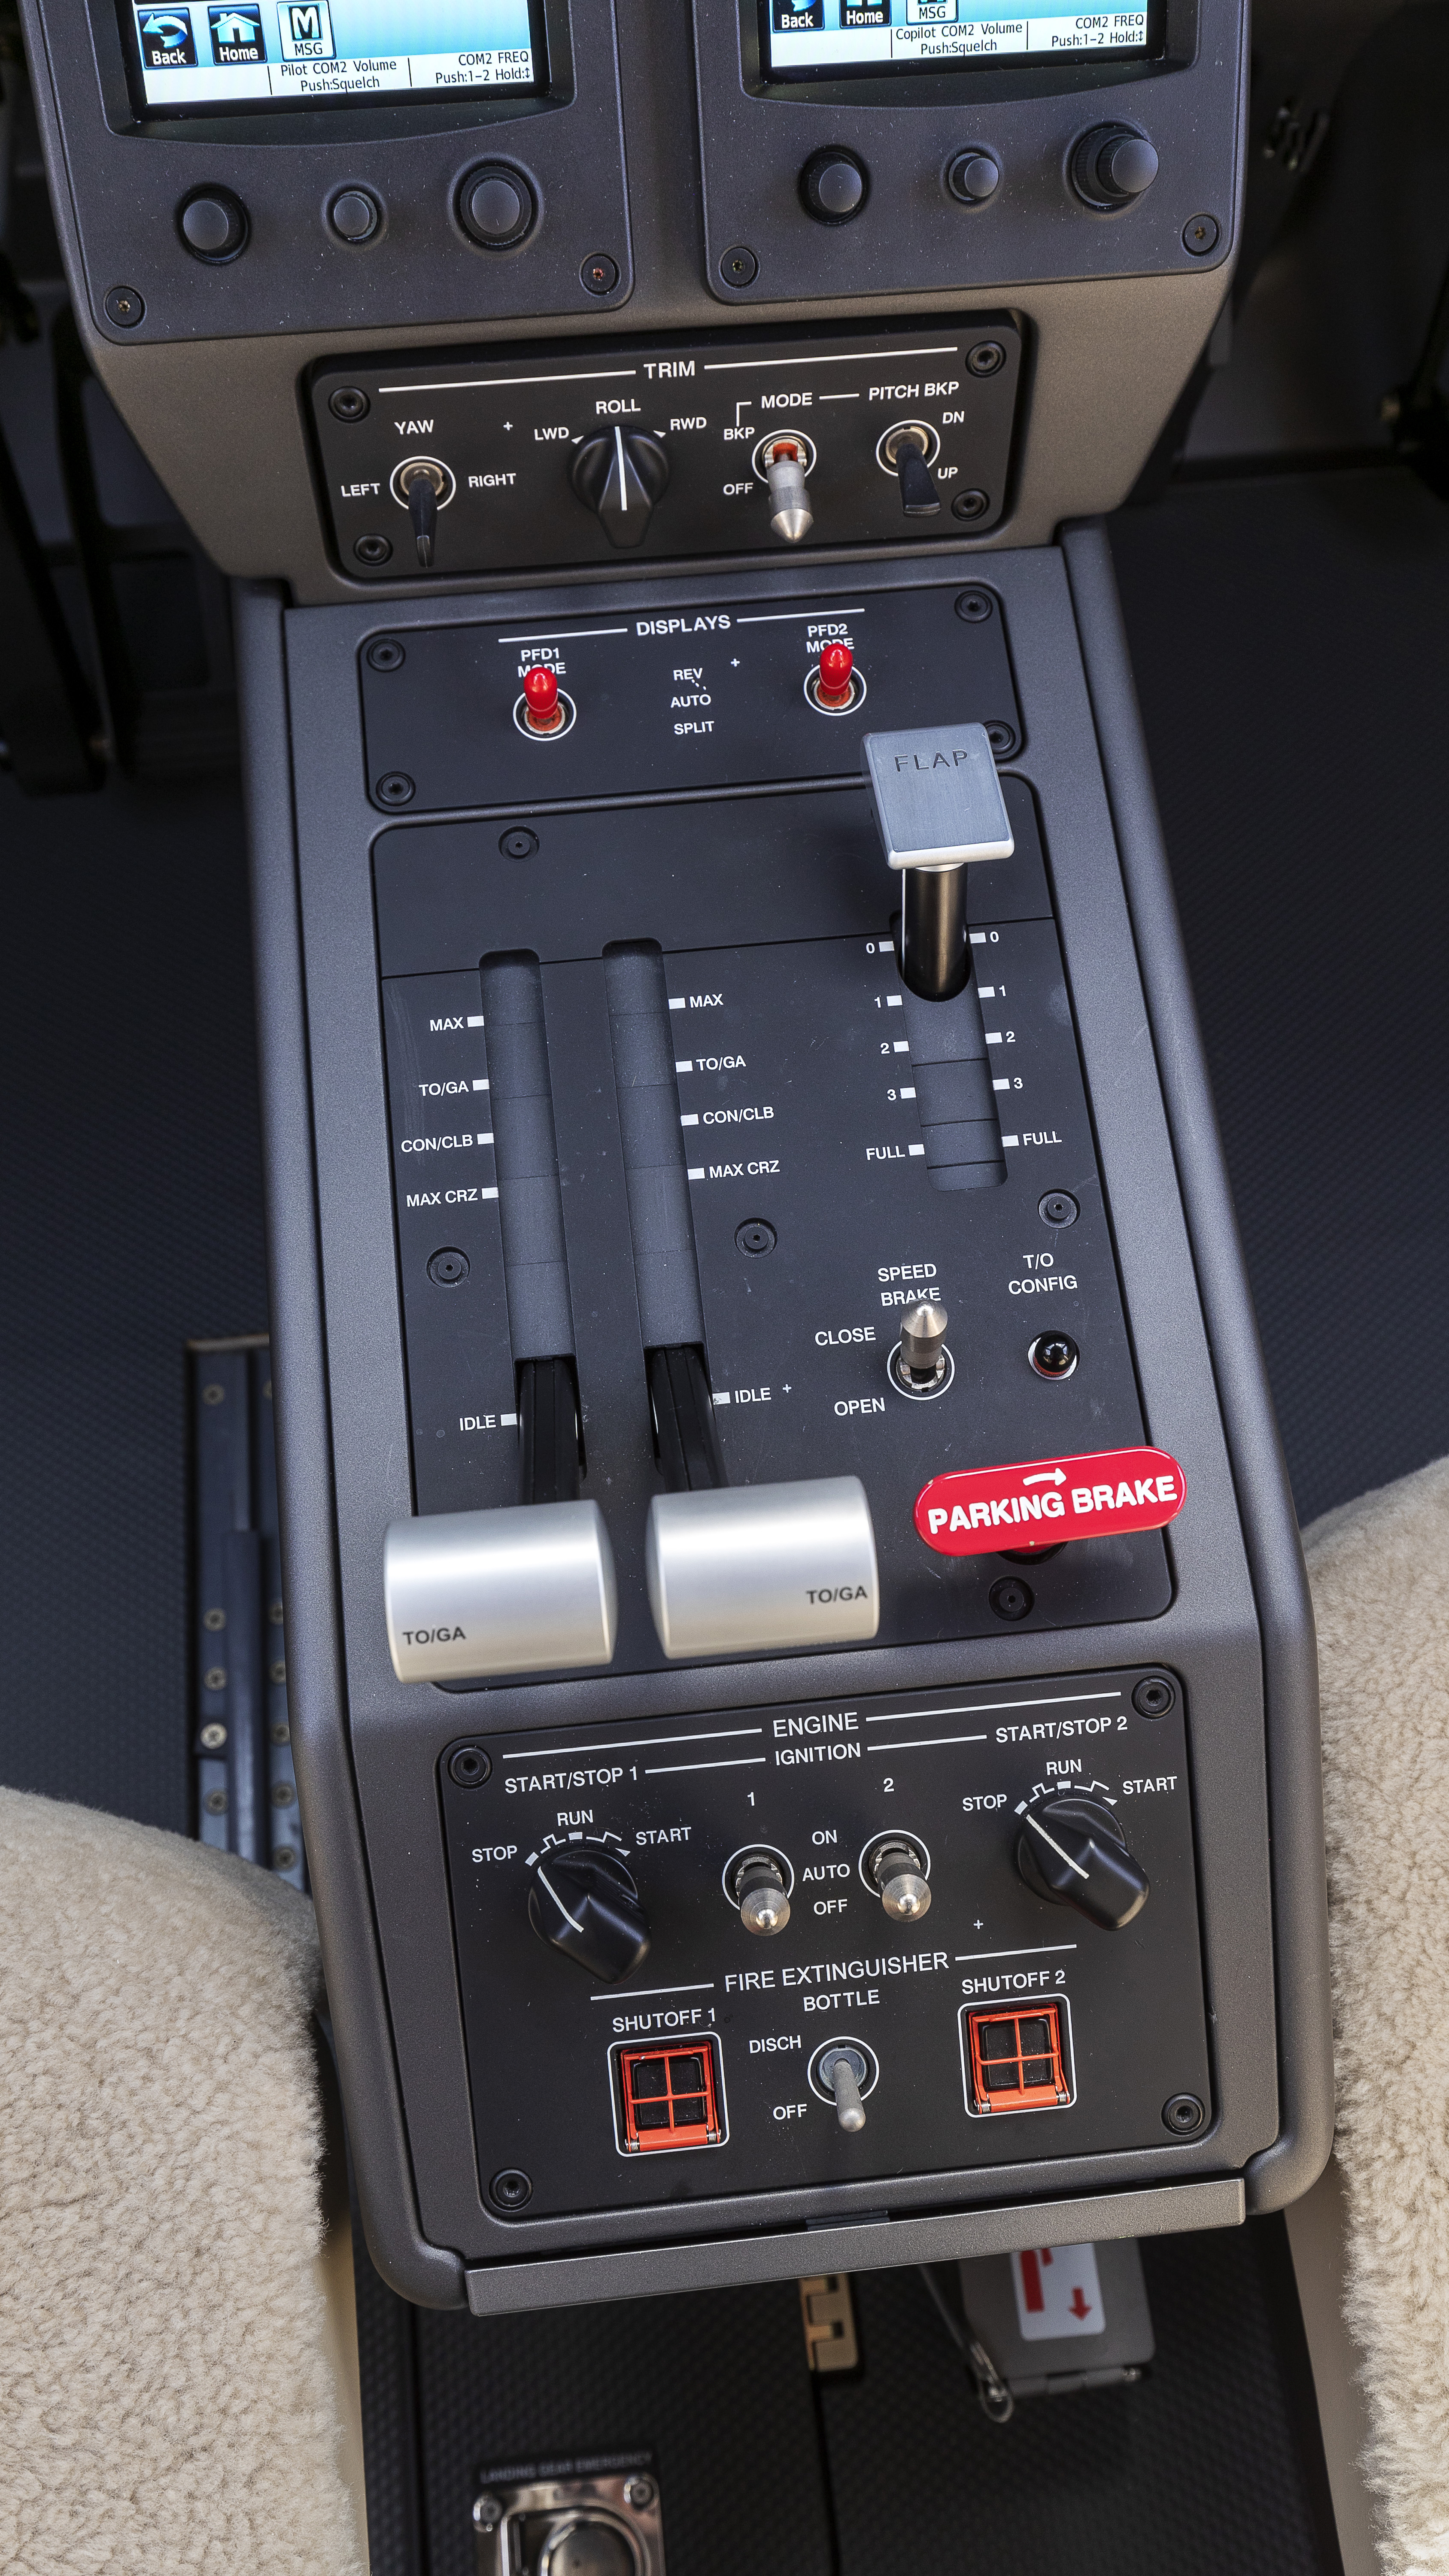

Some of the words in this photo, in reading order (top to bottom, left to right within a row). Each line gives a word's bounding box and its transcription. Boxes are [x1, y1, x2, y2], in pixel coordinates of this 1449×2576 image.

[781, 14, 814, 28] Back
[847, 11, 884, 24] Home
[919, 7, 945, 19] MSG
[1075, 17, 1108, 28] COM2
[1114, 15, 1144, 27] FREQ
[896, 27, 936, 42] Copilot
[942, 25, 974, 36] COM2
[981, 22, 1022, 34] Volume
[220, 47, 258, 61] Home
[295, 44, 323, 56] MSG
[921, 39, 997, 56] Push:Squelch
[152, 50, 186, 65] Back
[459, 54, 492, 66] COM2
[498, 52, 529, 65] FREQ
[281, 63, 308, 76] Pilot
[313, 62, 347, 74] COM2
[355, 60, 397, 72] Volume
[301, 76, 380, 94] Push:Squelch
[643, 360, 695, 379] TRIM
[869, 384, 919, 401] PITCH
[924, 381, 959, 397] BKP
[596, 398, 641, 414] ROLL
[761, 392, 813, 409] MODE
[670, 417, 707, 431] RWD
[942, 410, 965, 424] DN
[394, 419, 434, 435] YAW
[534, 427, 569, 440] LWD
[724, 427, 755, 440] BKP
[468, 473, 516, 488] RIGHT
[938, 467, 958, 479] UP
[341, 483, 380, 497] LEFT
[723, 483, 753, 495] OFF
[636, 615, 731, 636] DISPLAYS
[808, 624, 848, 637] PFD2
[521, 648, 559, 661] PFD1
[673, 667, 704, 681] REV
[671, 694, 711, 708] AUTO
[674, 720, 714, 735] SPLIT
[894, 749, 968, 772] FLAP
[990, 931, 999, 942] 0
[866, 942, 875, 954] 0
[999, 985, 1006, 996] 1
[690, 993, 724, 1008] MAX
[874, 996, 881, 1008] 1
[430, 1017, 464, 1031] MAX
[1006, 1031, 1016, 1043] 2
[880, 1042, 890, 1054] 2
[696, 1055, 746, 1071] TO/GA
[418, 1081, 469, 1097] TO/GA
[1013, 1077, 1023, 1089] 3
[887, 1089, 896, 1101] 3
[703, 1106, 774, 1124] CON/CLB
[401, 1134, 473, 1152] CON/CLB
[1023, 1131, 1062, 1146] FULL
[866, 1145, 905, 1160] FULL
[709, 1163, 744, 1179] MAX
[747, 1160, 780, 1175] CRZ
[406, 1191, 441, 1207] MAX
[445, 1188, 478, 1203] CRZ
[1022, 1253, 1054, 1270] T/O
[878, 1264, 937, 1282] SPEED
[1008, 1275, 1078, 1295] CONFIG
[815, 1326, 876, 1346] CLOSE
[735, 1387, 772, 1403] IDLE
[834, 1397, 885, 1416] OPEN
[459, 1414, 496, 1431] IDLE
[928, 1492, 1065, 1534] PARKING
[1071, 1475, 1178, 1514] BRAKE
[806, 1586, 868, 1604] TO/GA
[402, 1627, 466, 1645] TO/GA
[773, 1712, 859, 1738] ENGINE
[996, 1717, 1112, 1743] START/STOP
[1117, 1716, 1128, 1731] 2
[775, 1742, 861, 1766] IGNITION
[1046, 1759, 1082, 1776] RUN
[505, 1767, 623, 1794] START/STOP
[629, 1766, 637, 1780] 1
[883, 1777, 894, 1792] 2
[1123, 1776, 1178, 1795] START
[747, 1792, 755, 1806] 1
[963, 1794, 1007, 1811] STOP
[557, 1809, 593, 1826] RUN
[636, 1826, 692, 1845] START
[812, 1829, 837, 1845] ON
[472, 1845, 517, 1862] STOP
[802, 1863, 851, 1881] AUTO
[814, 1899, 848, 1915] OFF
[725, 1970, 775, 1992] FIRE
[782, 1952, 949, 1986] EXTINGUISHER
[962, 1971, 1053, 1998] SHUTOFF
[1055, 1970, 1066, 1984] 2
[803, 1989, 880, 2011] BOTTLE
[613, 2008, 705, 2036] SHUTOFF
[708, 2008, 715, 2022] 1
[749, 2035, 802, 2054] DISCH
[773, 2103, 807, 2120] OFF
